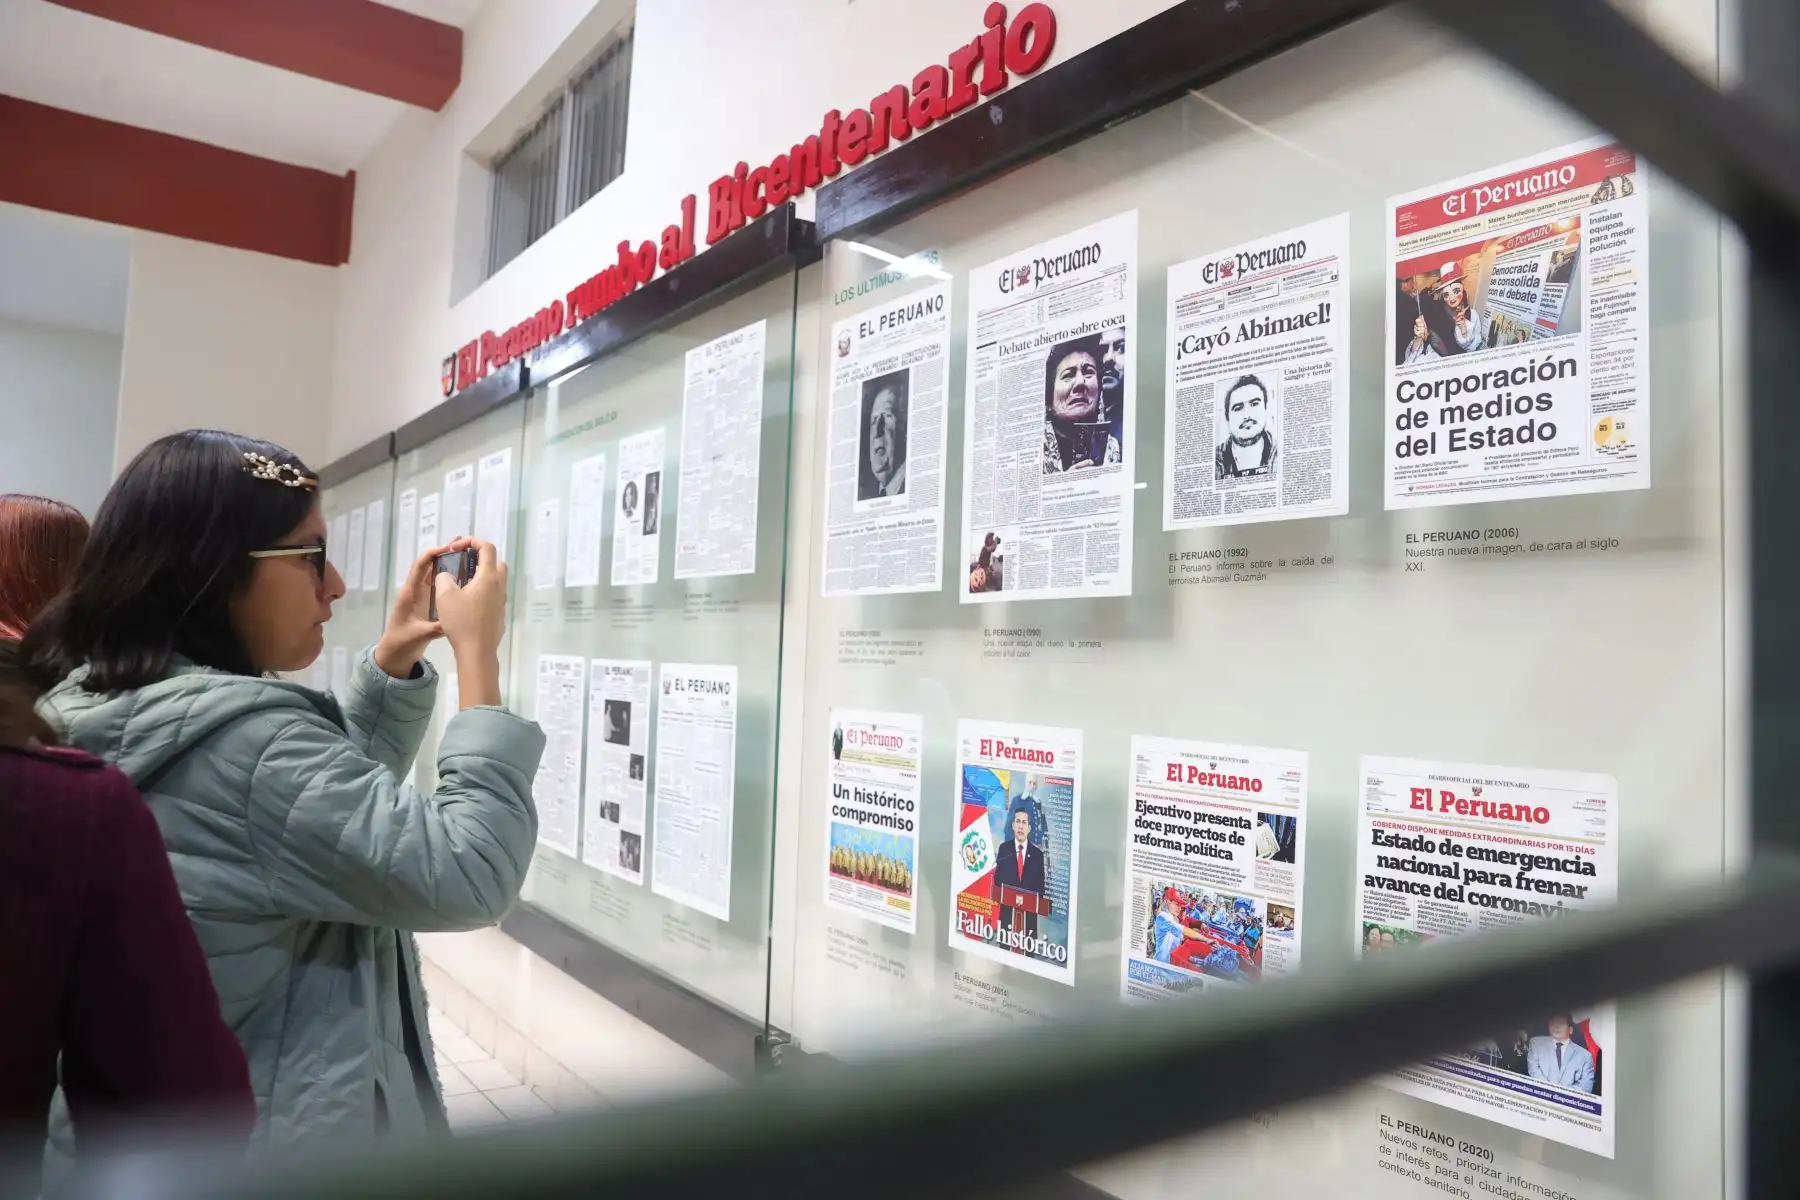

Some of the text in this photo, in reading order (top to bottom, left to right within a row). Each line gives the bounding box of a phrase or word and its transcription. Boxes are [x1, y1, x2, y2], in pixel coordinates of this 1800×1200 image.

[457, 2, 1056, 391] El Peruano rumbo al Bicentenario
[1443, 165, 1576, 217] El Peruano
[1589, 211, 1623, 225] Instalan
[1589, 221, 1624, 235] equipos
[1589, 227, 1635, 245] para medir
[1589, 239, 1627, 254] polución
[999, 243, 1102, 294] El Peruano
[1202, 239, 1307, 285] El Peruano
[1491, 260, 1539, 276] Democracia
[834, 286, 855, 306] LOS
[1497, 275, 1541, 288] consolida
[1499, 288, 1506, 297] el
[1506, 288, 1538, 304] debate
[859, 294, 944, 339] EL PERUANO
[1177, 326, 1231, 361] ¡Cayó
[1235, 302, 1332, 344] Abimael!
[999, 314, 1126, 357] Debate abierto sobre coca
[1284, 361, 1333, 376] Una historia de
[1395, 355, 1578, 404] Corporación
[1395, 391, 1553, 431] de medios
[1395, 432, 1436, 459] del
[1449, 419, 1557, 453] Estado
[1405, 527, 1520, 544] EL PERUANO (2006)
[1405, 537, 1620, 558] Nuestra nueva imagen, de cara al siglo
[1168, 547, 1249, 562] EL PERUANO (1992)
[1168, 564, 1176, 574] El
[1180, 563, 1212, 573] Peruano
[1216, 561, 1245, 572] informa
[1250, 559, 1273, 569] sobre
[1278, 558, 1286, 567] la
[1320, 555, 1335, 565] del
[1405, 561, 1426, 573] XXI.
[1168, 576, 1200, 586] terrorista
[1201, 573, 1233, 584] Abimael
[675, 677, 731, 696] EL PERUANO
[846, 728, 904, 749] El Peruano
[980, 738, 1054, 764] El Peruano
[1166, 762, 1263, 793] El Peruano
[1484, 779, 1530, 789] BICENTENARIO
[832, 783, 914, 812] Un histórico
[1410, 786, 1433, 812] El
[1440, 790, 1550, 825] Peruano
[832, 804, 914, 832] compromiso
[1135, 799, 1192, 821] Ejecutivo
[1193, 811, 1252, 830] presenta
[1134, 816, 1246, 846] doce proyectos de
[1372, 820, 1596, 855] GOBIERNO DISPONE MEDIDAS EXTRAORDINARIAS POR 15 DÍAS
[1134, 833, 1234, 861] reforma política
[1371, 828, 1597, 877] Estado de emergencia
[1364, 873, 1431, 898] avance
[1434, 884, 1465, 904] del
[1377, 854, 1588, 900] nacional para frenar
[957, 909, 1067, 962] Fallo histórico
[1380, 1113, 1495, 1164] EL PERUANO (2020)
[1379, 1128, 1418, 1151] Nuevos
[1422, 1144, 1452, 1164] retos,
[1456, 1156, 1502, 1181] priorizar
[1379, 1144, 1392, 1156] de
[1396, 1150, 1431, 1170] interés
[1435, 1163, 1460, 1182] para
[1464, 1174, 1474, 1186] el
[1379, 1158, 1473, 1200] contexto sanitario.
